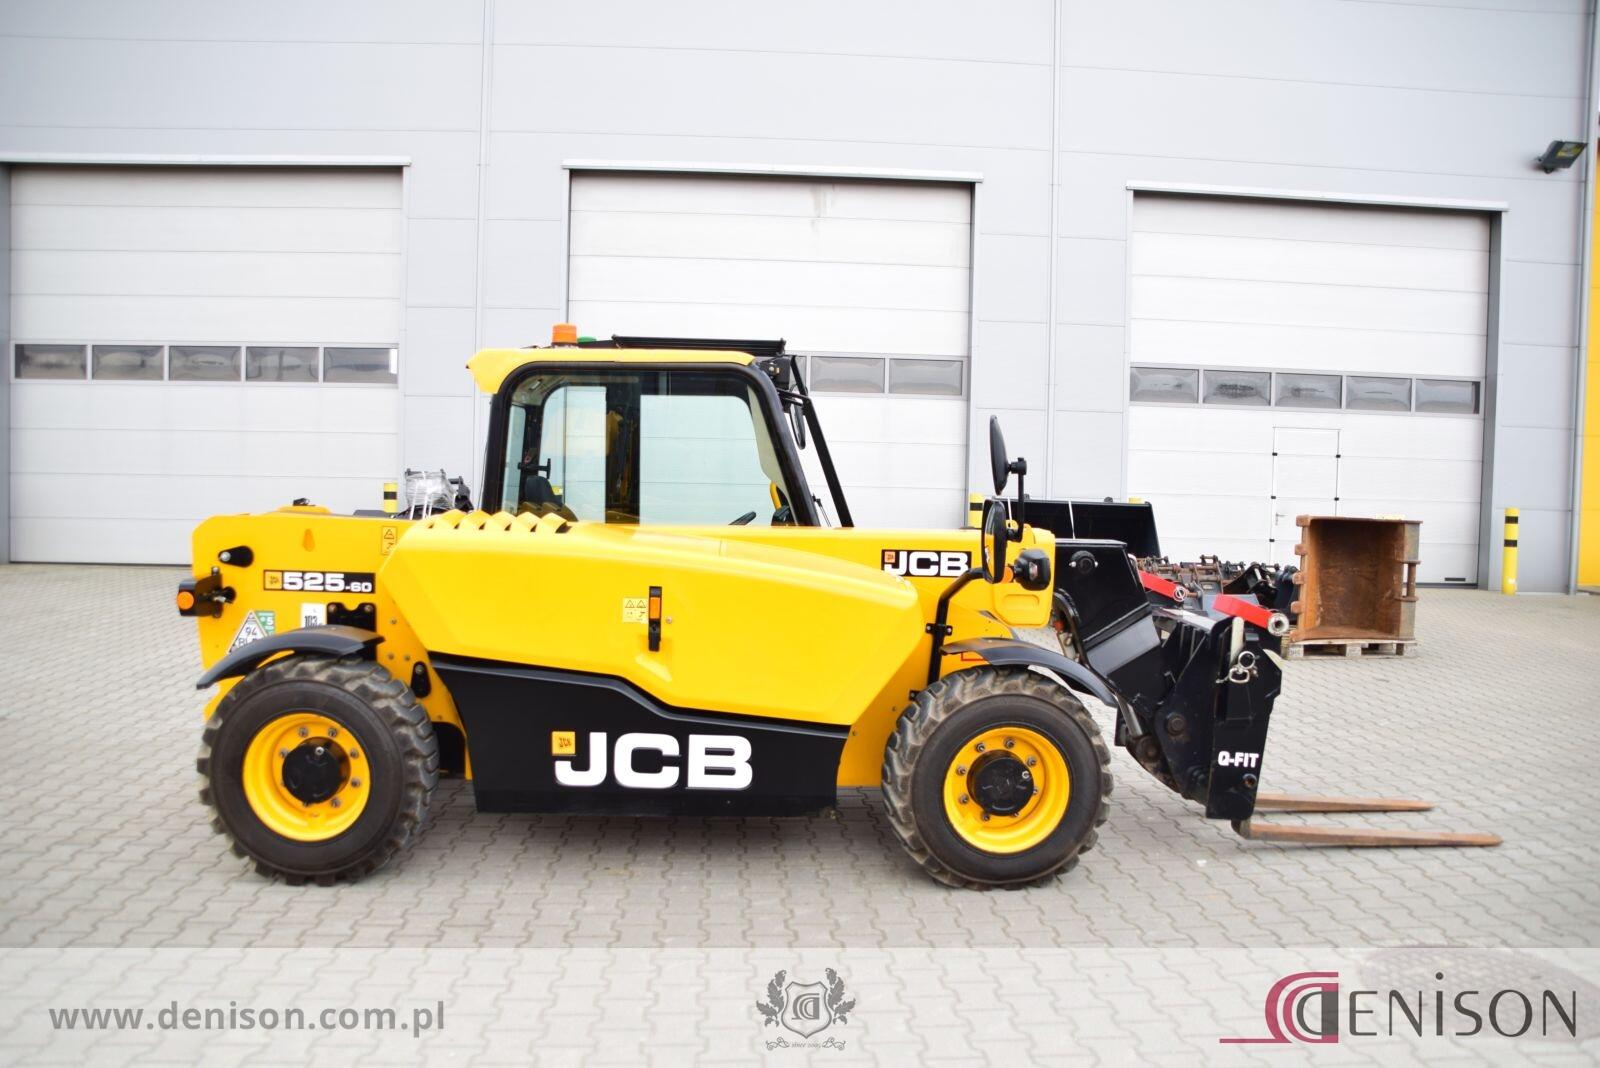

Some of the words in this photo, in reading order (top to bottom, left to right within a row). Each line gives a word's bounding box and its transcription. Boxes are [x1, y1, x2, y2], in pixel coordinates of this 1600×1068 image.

[884, 551, 969, 577] JCB
[283, 571, 373, 593] 525-60
[554, 732, 753, 790] JCB
[1217, 750, 1260, 768] Q-FIT
